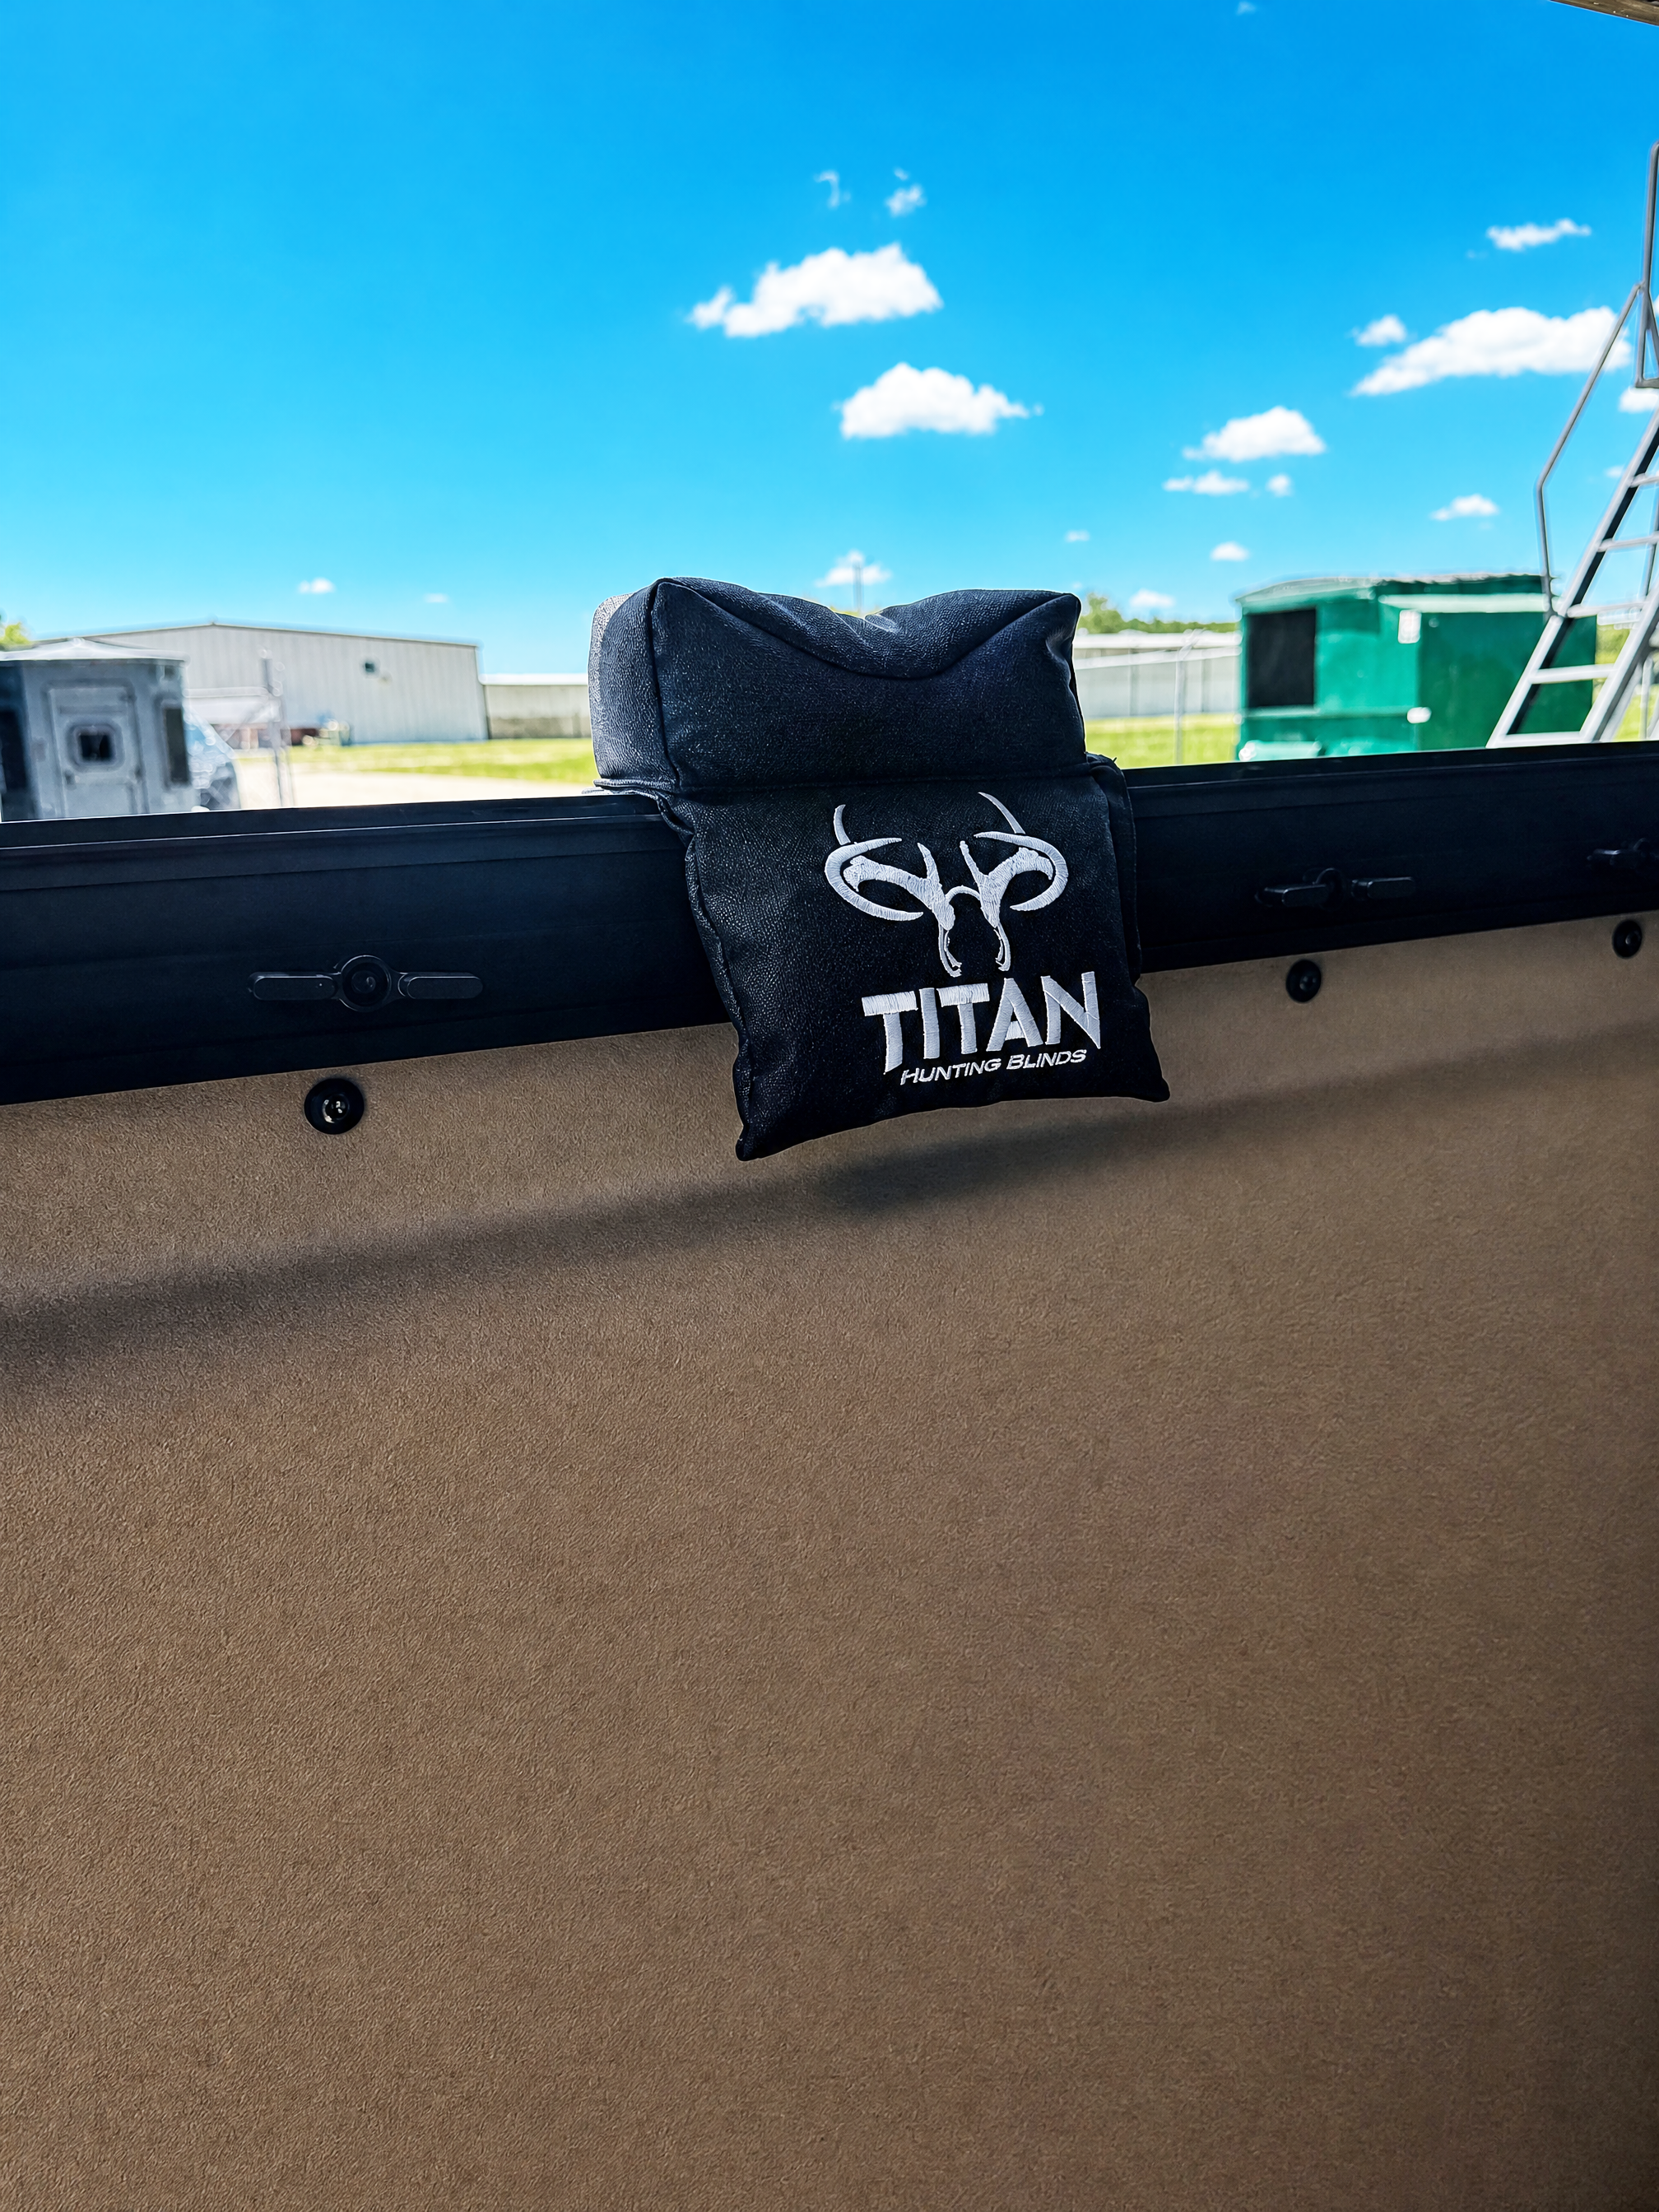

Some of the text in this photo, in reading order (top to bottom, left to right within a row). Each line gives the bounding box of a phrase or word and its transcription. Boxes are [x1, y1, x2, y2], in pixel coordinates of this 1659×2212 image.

[861, 971, 1101, 1075] TITAN
[899, 1049, 1087, 1085] HUNTING BLINDS
